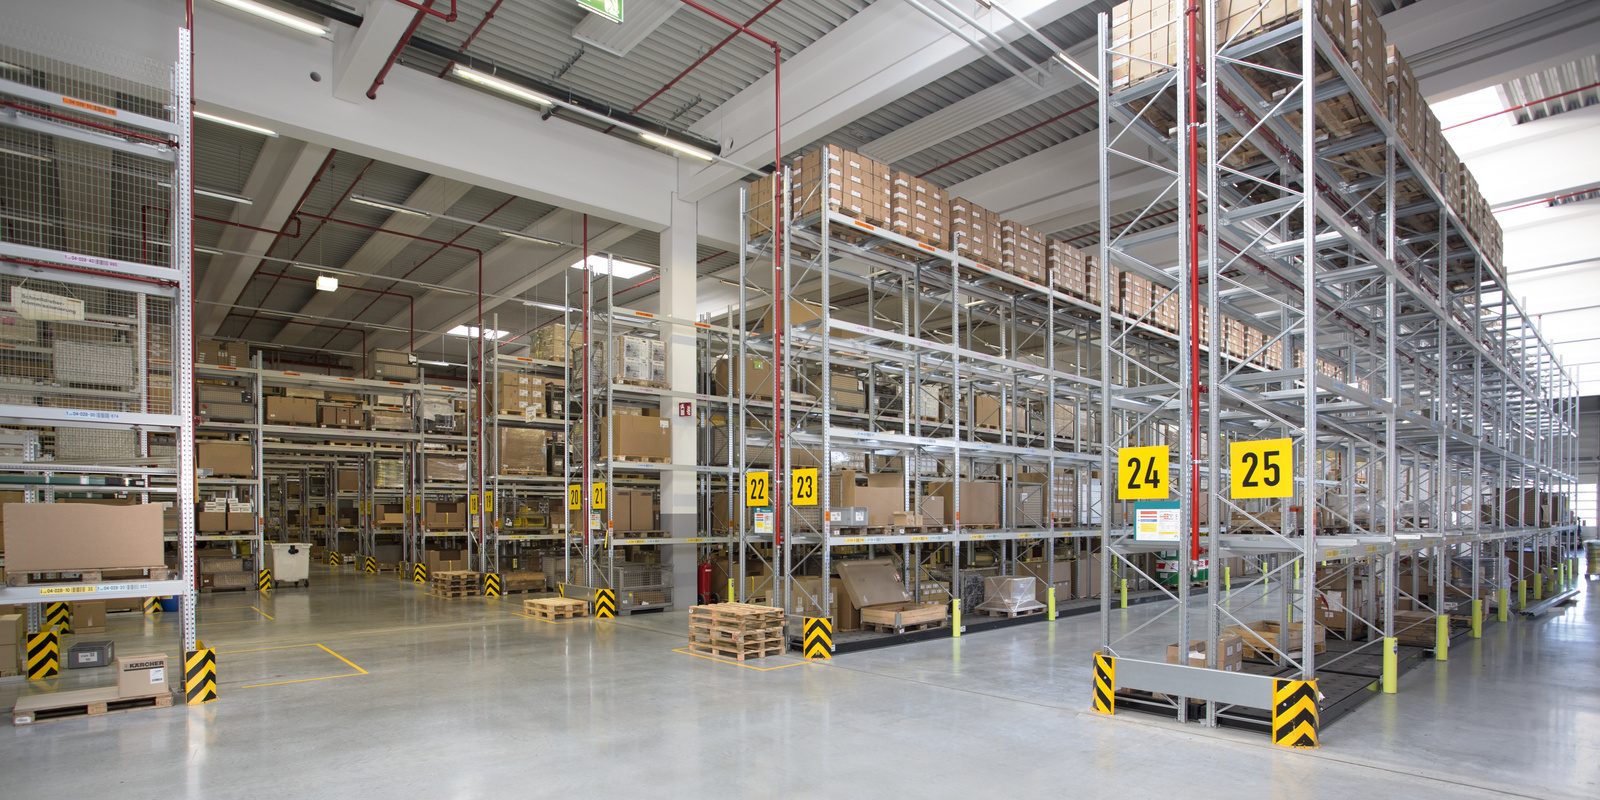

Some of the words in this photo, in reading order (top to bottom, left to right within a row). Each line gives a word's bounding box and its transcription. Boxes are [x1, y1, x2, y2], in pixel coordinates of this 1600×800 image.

[1128, 456, 1160, 489] 24
[1242, 450, 1280, 487] 25
[595, 488, 603, 504] 21
[751, 478, 764, 499] 22
[797, 476, 812, 498] 23
[472, 498, 476, 510] 18
[486, 495, 491, 508] 19
[571, 490, 578, 505] 20
